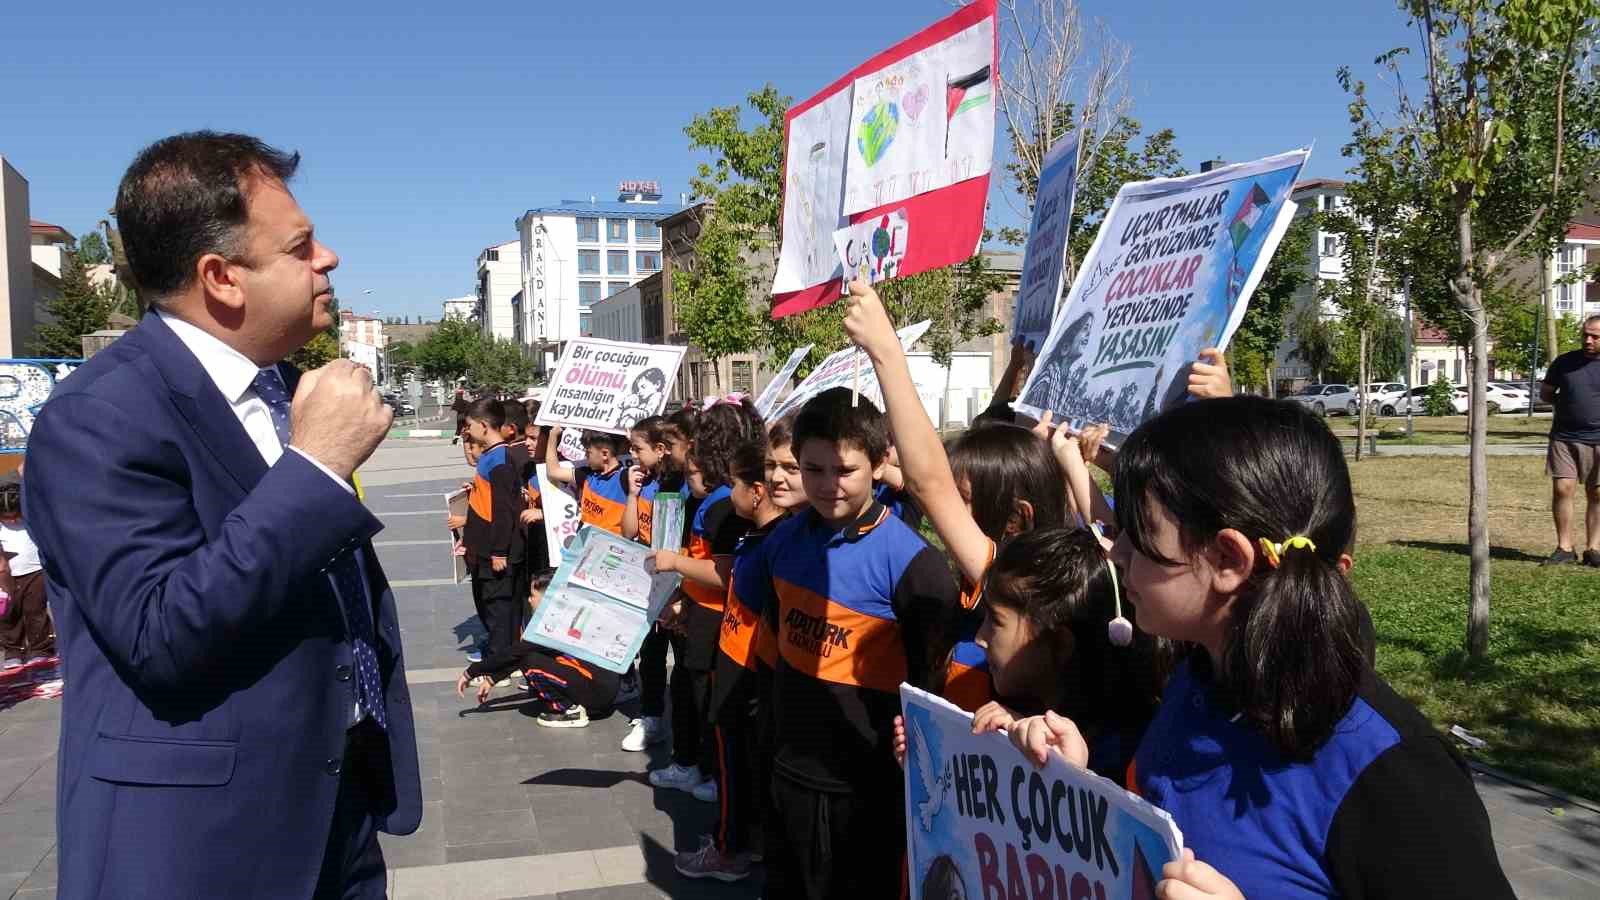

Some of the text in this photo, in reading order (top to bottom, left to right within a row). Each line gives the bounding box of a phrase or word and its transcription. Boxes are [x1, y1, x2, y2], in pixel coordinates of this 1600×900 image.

[1120, 190, 1230, 246] UÇURTMALAR
[534, 225, 544, 290] GRAND
[1124, 222, 1217, 266] GÖKYÜZÜNDE,
[1103, 255, 1202, 310] ÇOCUKLAR
[1103, 293, 1193, 329] YERYÜZÜNDE
[572, 345, 649, 367] Bir çocuğun
[1092, 322, 1180, 367] YAŞASIN!
[555, 386, 615, 404] insanlığın
[565, 363, 627, 391] ölümü,
[550, 401, 614, 422] kaybıdır!
[785, 608, 853, 649] ATATÜRK
[952, 752, 1120, 878] HER ÇOCUK
